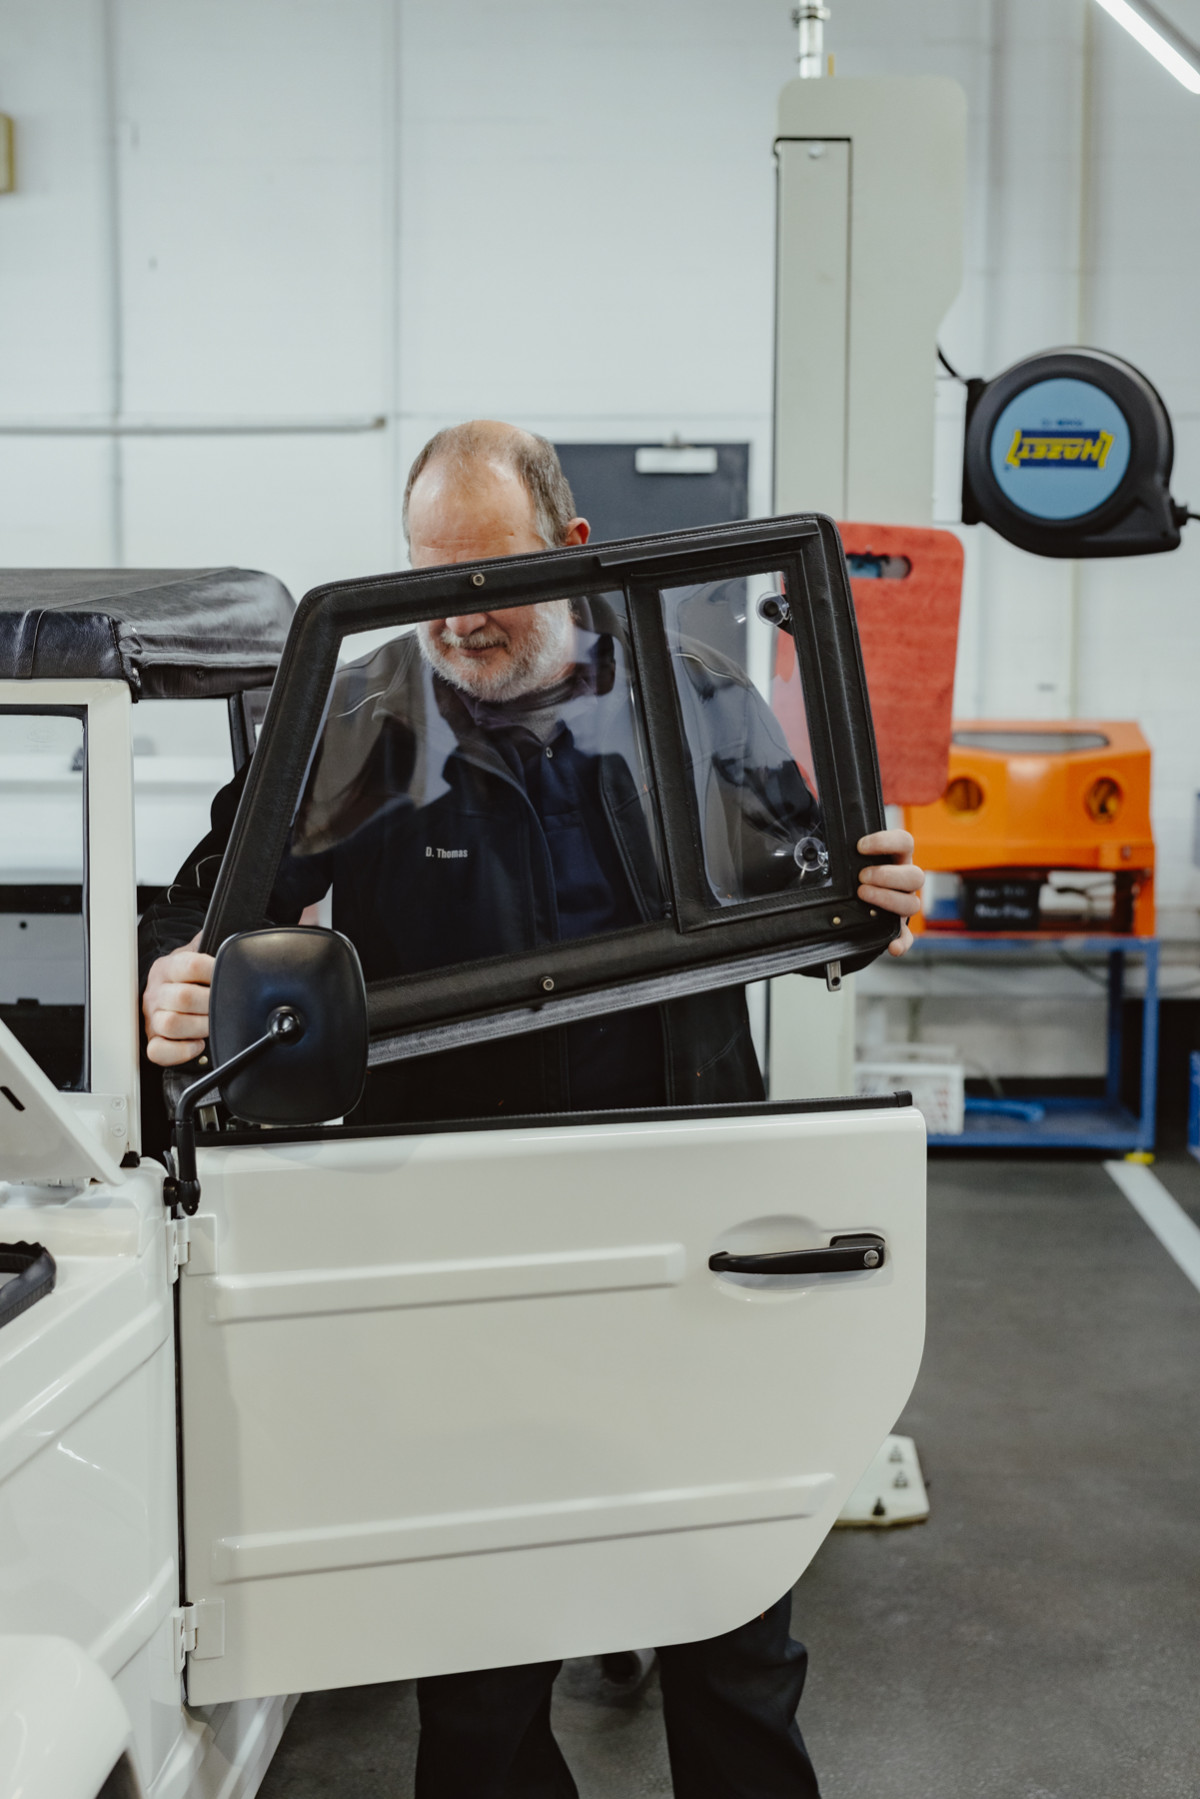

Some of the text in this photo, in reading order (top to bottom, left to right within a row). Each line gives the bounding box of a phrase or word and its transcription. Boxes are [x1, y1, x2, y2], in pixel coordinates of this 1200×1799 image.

[1015, 437, 1106, 463] HAZET
[425, 846, 469, 859] D. Thomas
